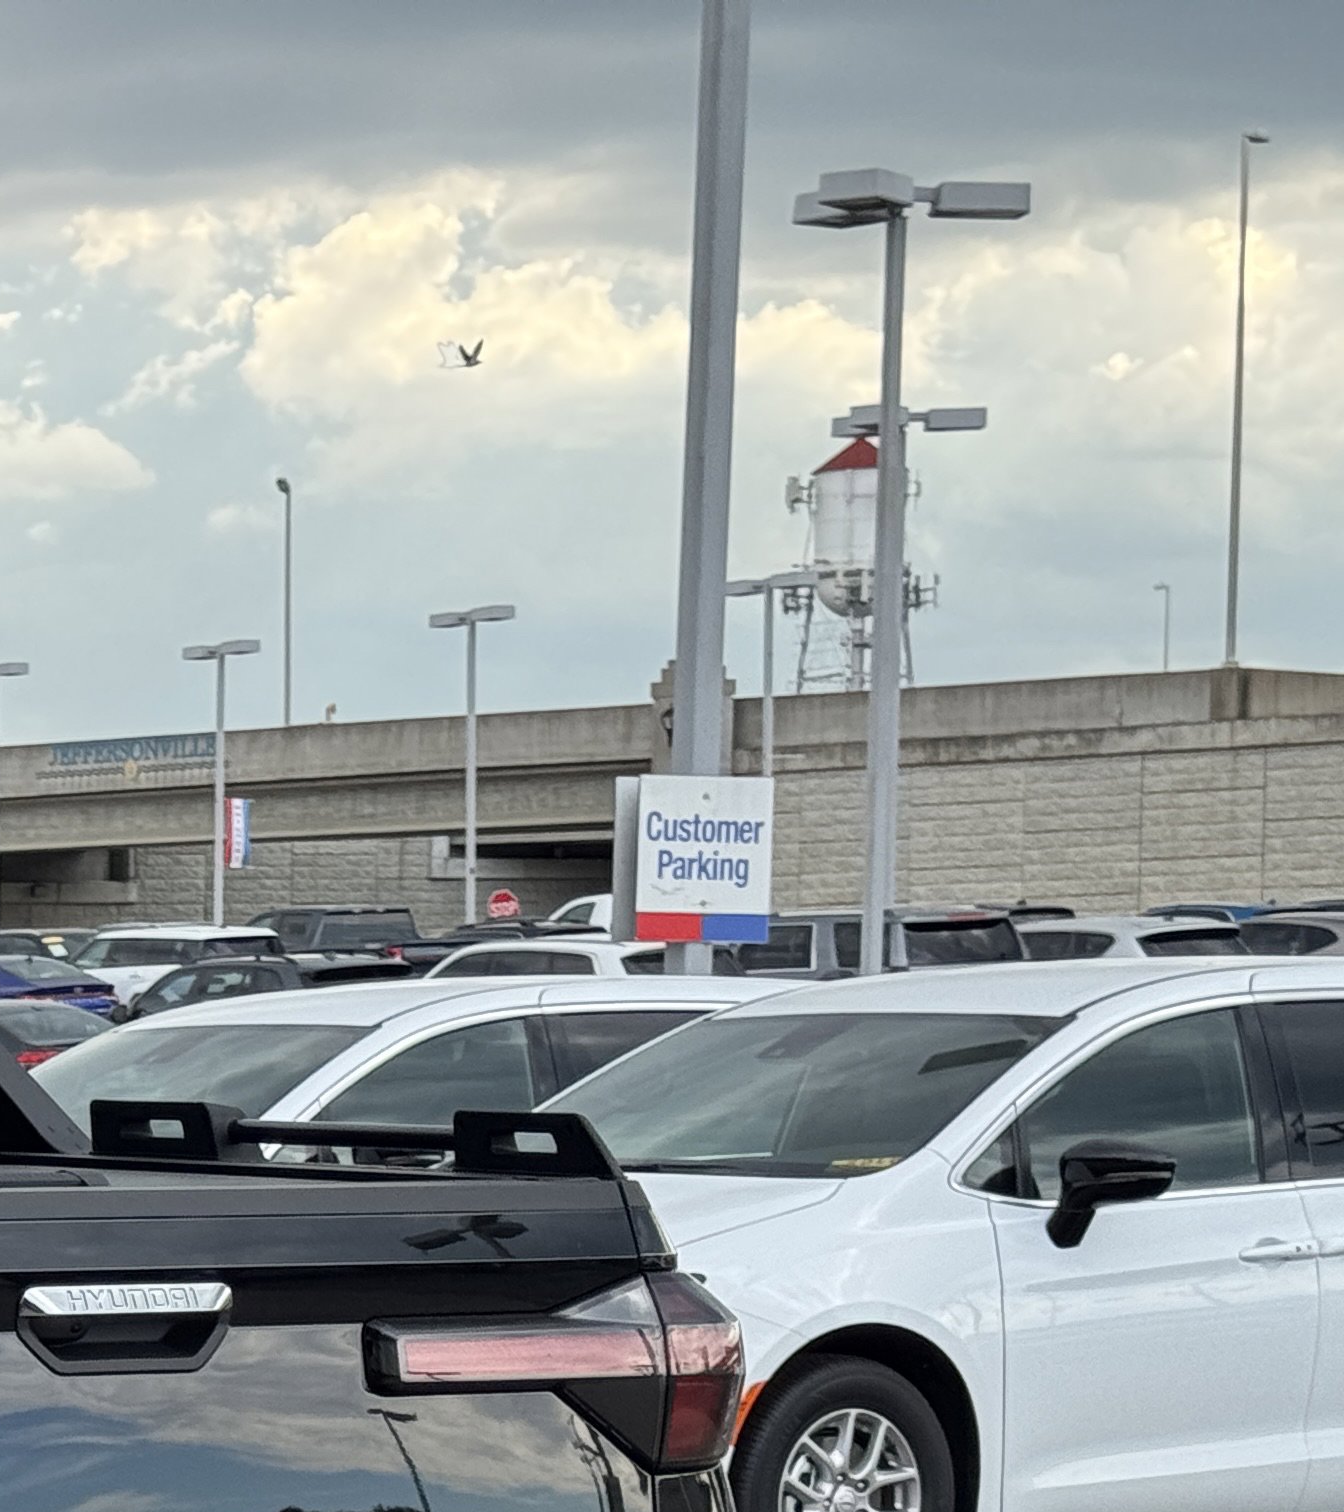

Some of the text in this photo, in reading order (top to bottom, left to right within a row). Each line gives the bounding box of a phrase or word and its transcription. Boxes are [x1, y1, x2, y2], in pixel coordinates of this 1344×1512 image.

[49, 733, 216, 766] JEFFERSONVILLE
[647, 811, 765, 844] Customer
[658, 850, 749, 888] Parking
[66, 1286, 200, 1312] HYUNDAI
